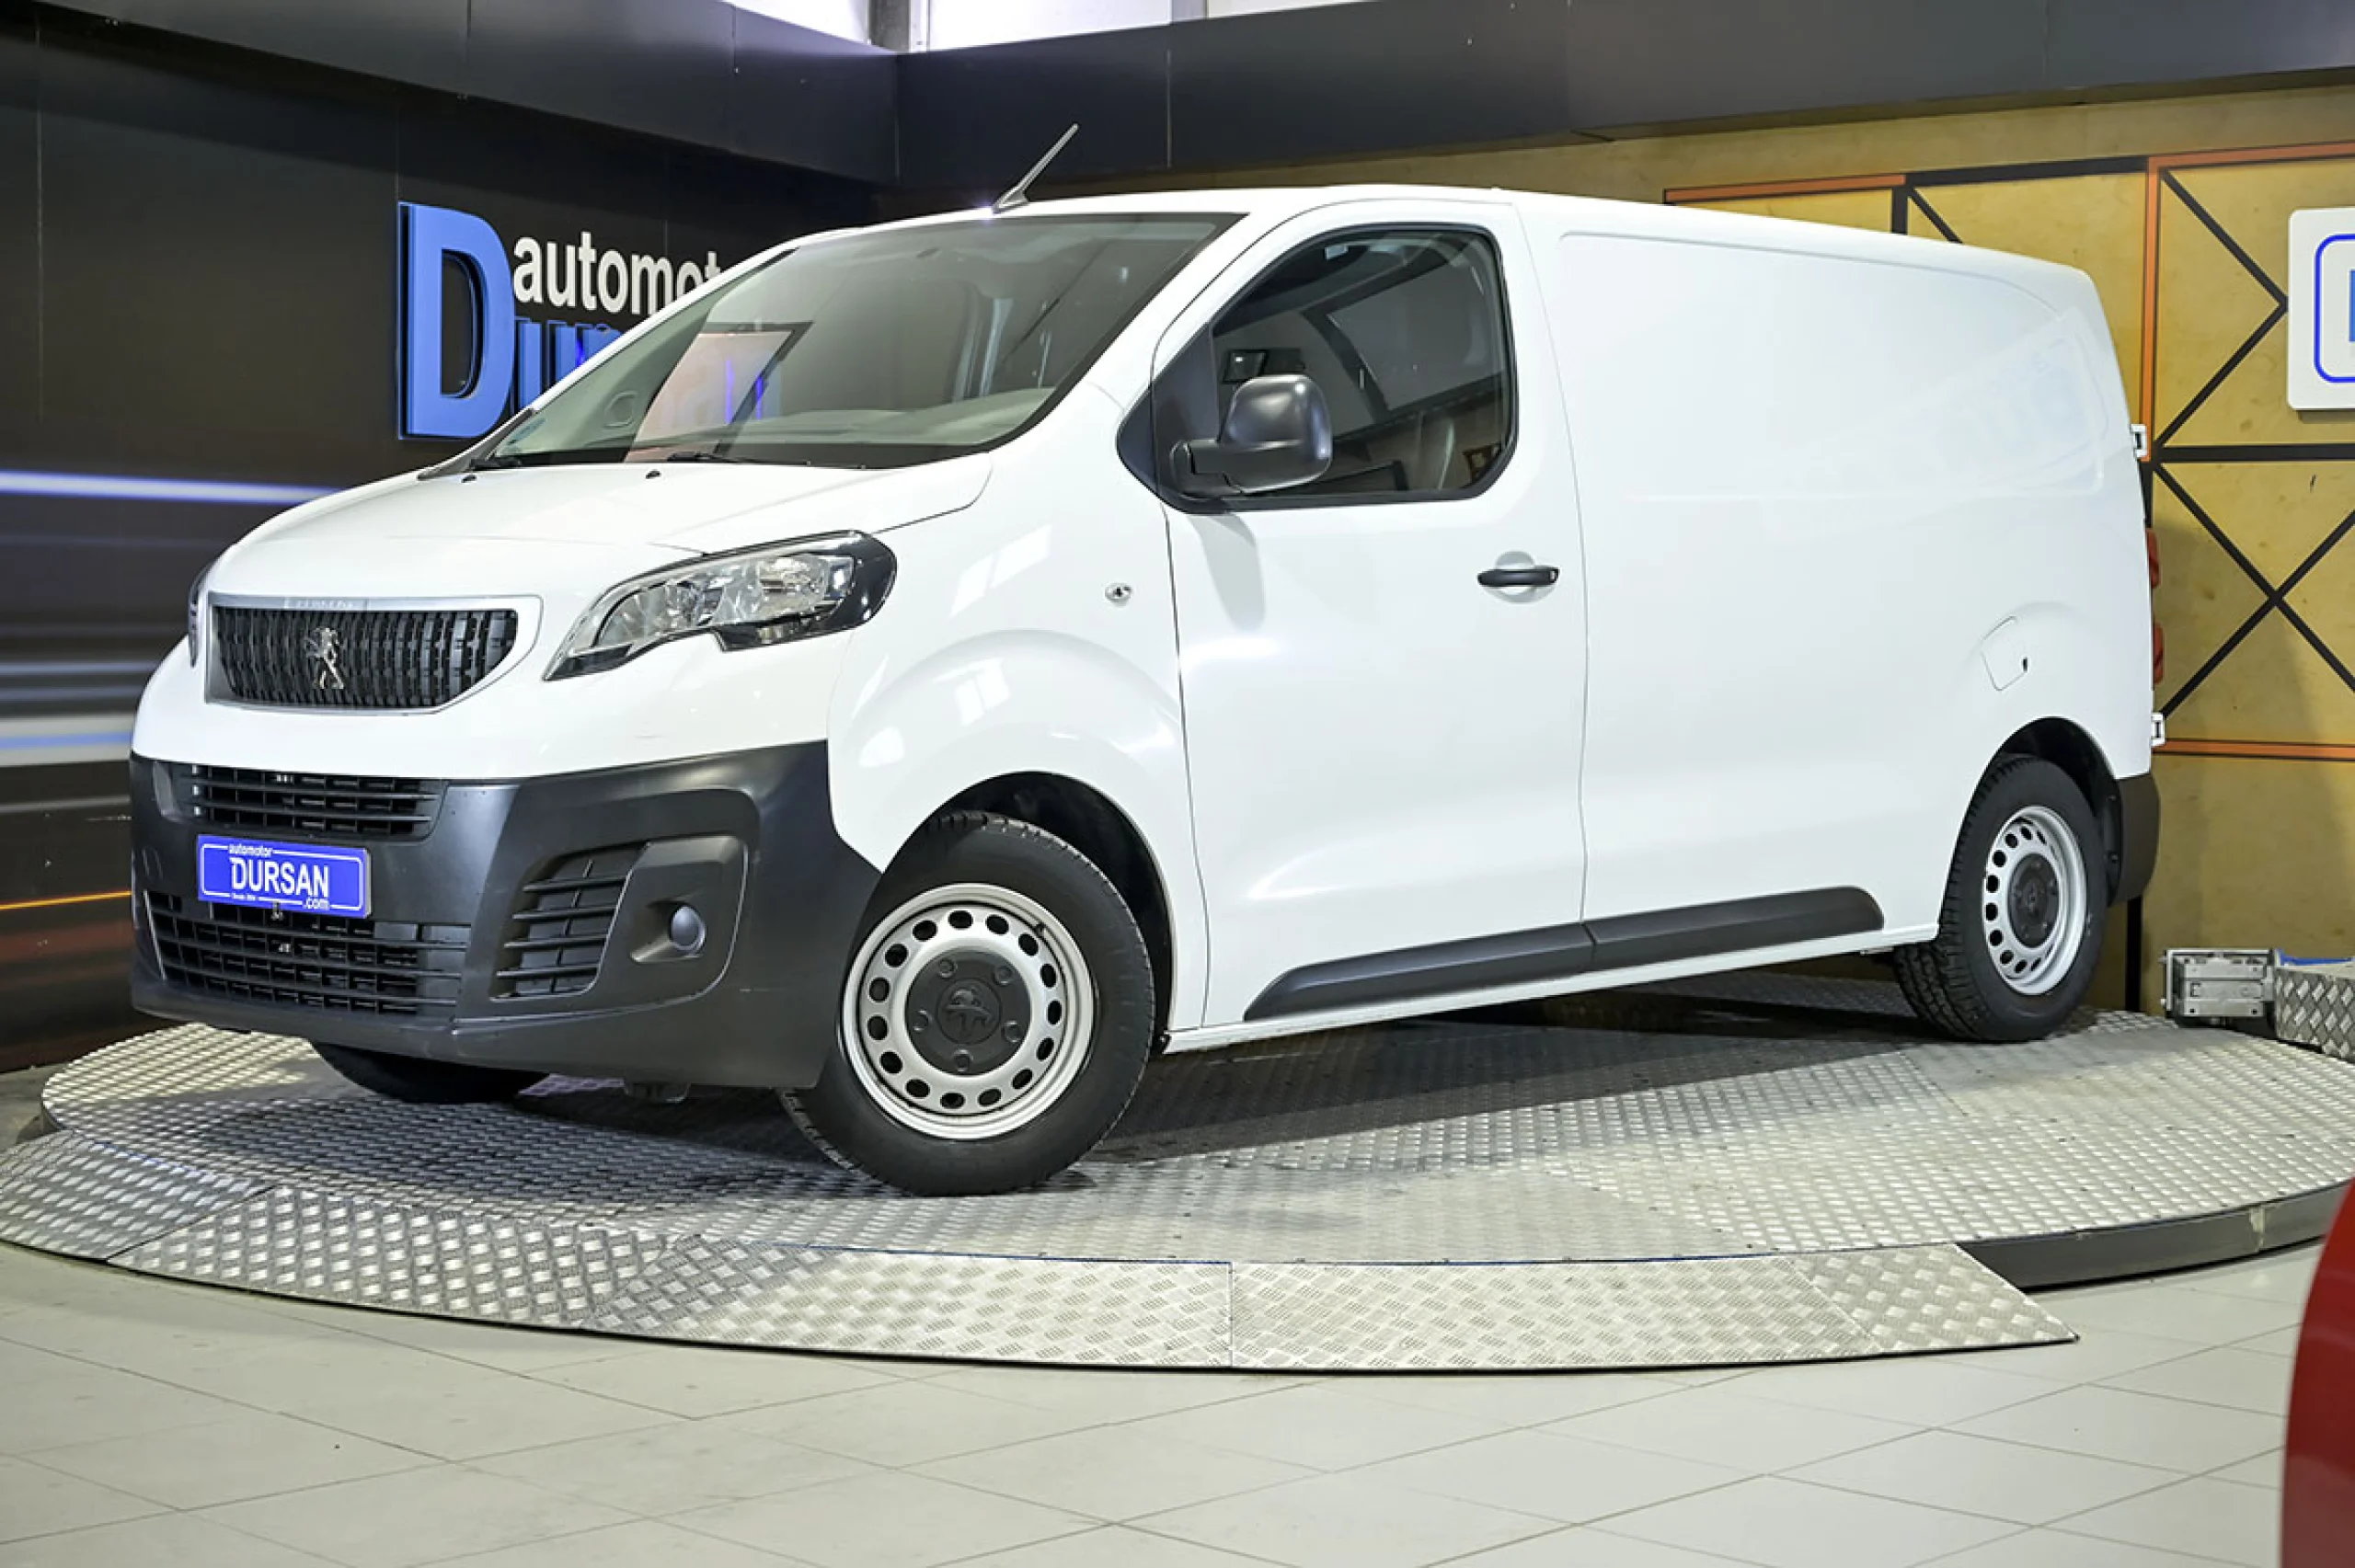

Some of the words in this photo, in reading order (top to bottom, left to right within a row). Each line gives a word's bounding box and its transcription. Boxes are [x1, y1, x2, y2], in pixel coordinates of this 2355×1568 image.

[229, 843, 272, 857] automotor
[229, 857, 329, 898] DURSAN
[303, 898, 329, 910] .com
